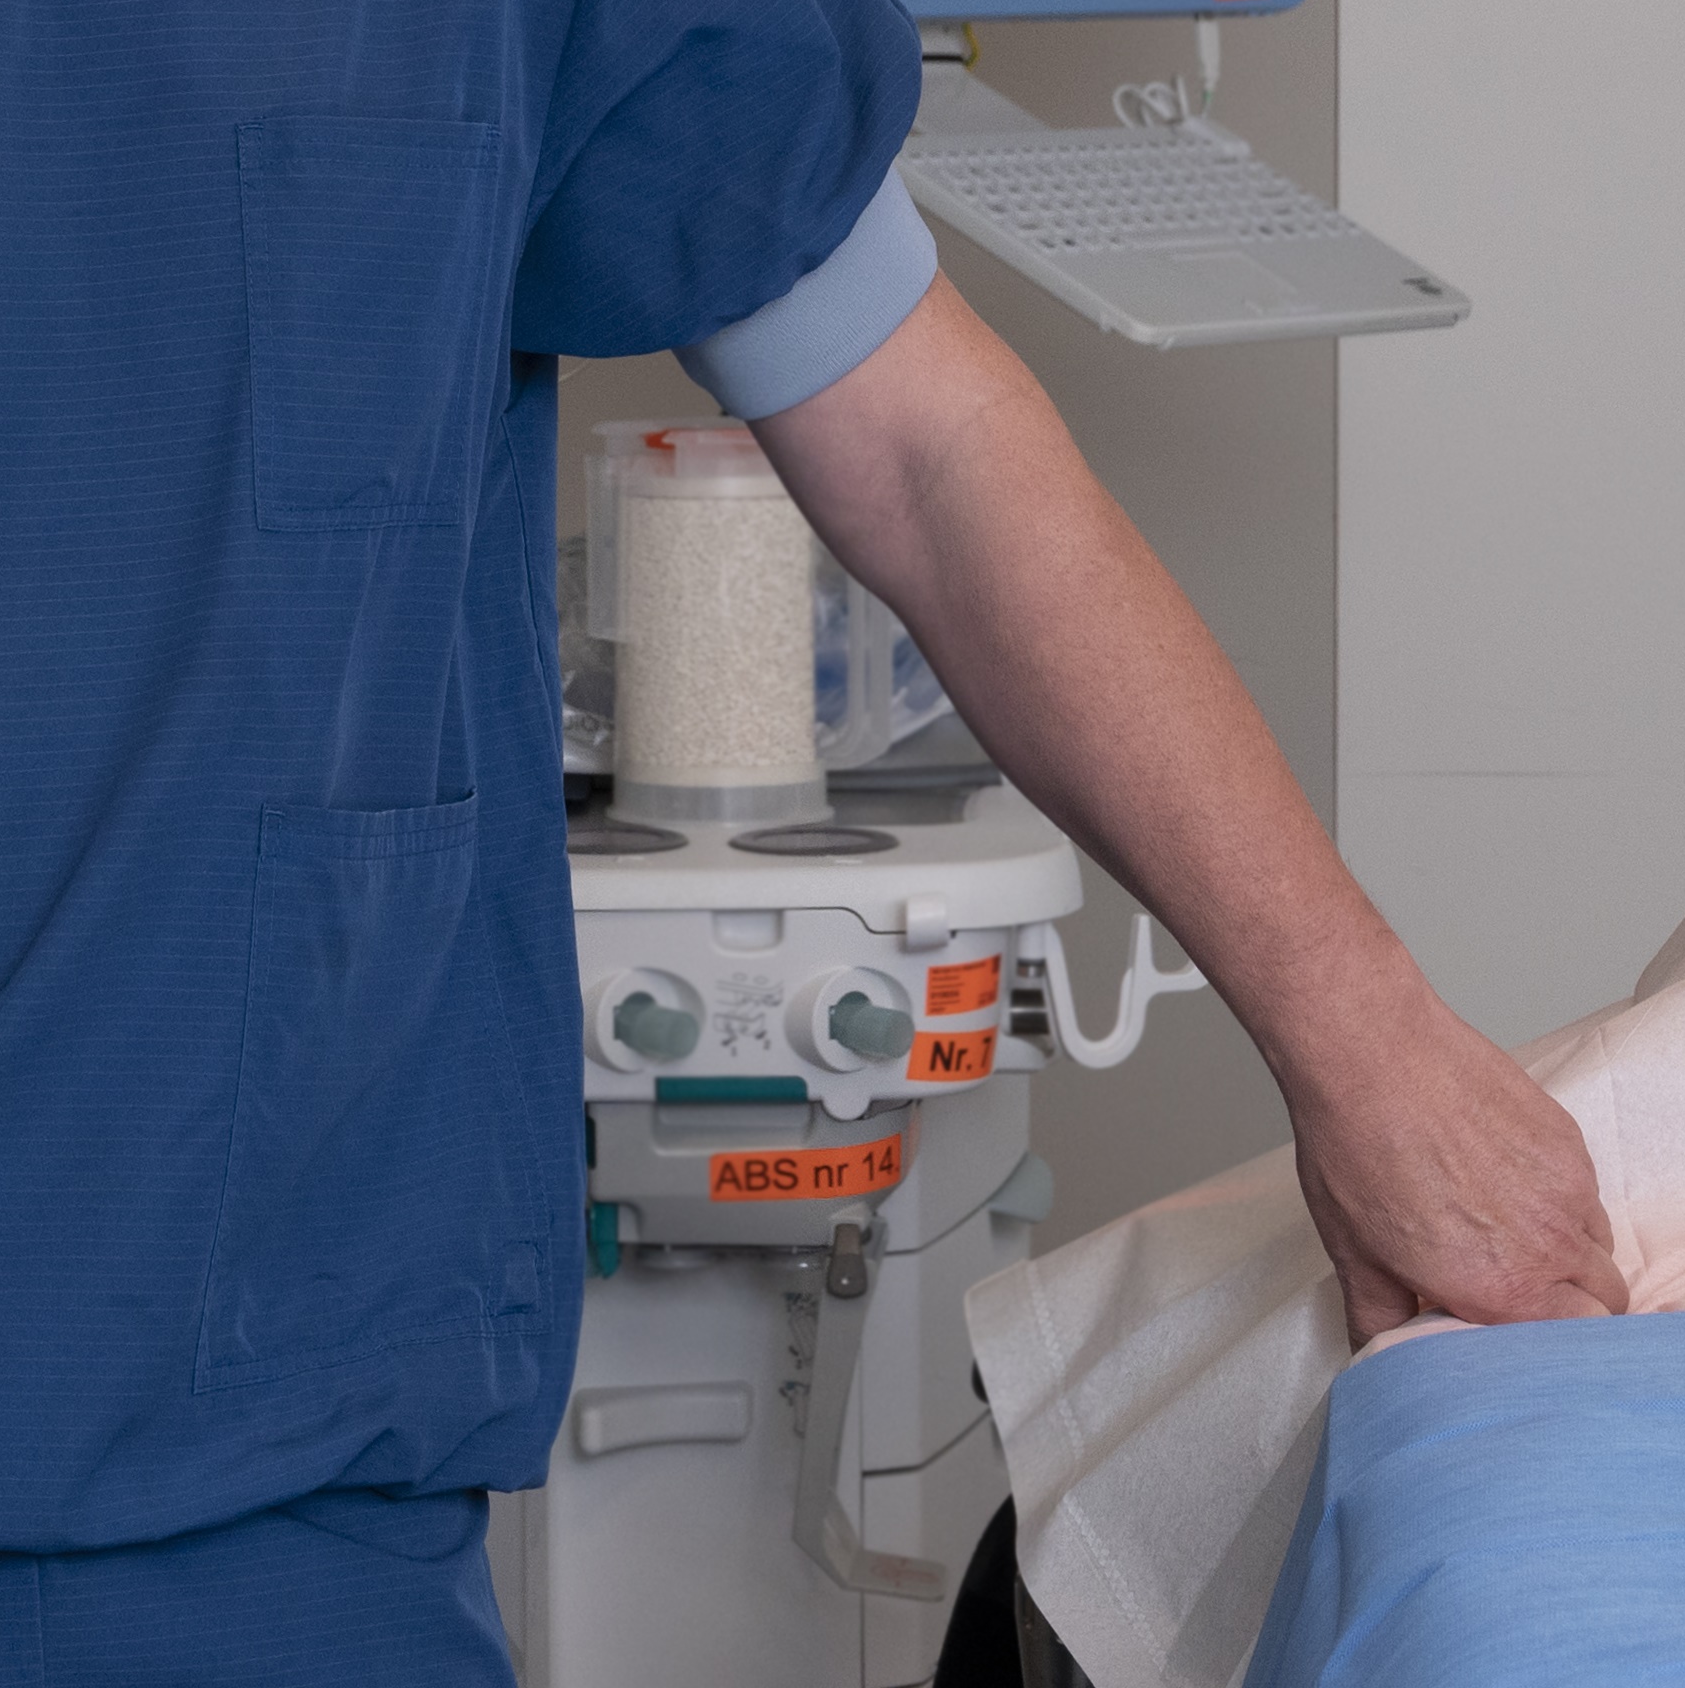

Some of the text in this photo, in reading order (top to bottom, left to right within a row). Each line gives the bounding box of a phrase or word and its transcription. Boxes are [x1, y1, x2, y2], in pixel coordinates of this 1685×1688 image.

[929, 1041, 973, 1072] Nr.
[715, 1158, 799, 1192] ABS
[814, 1164, 849, 1189] nr
